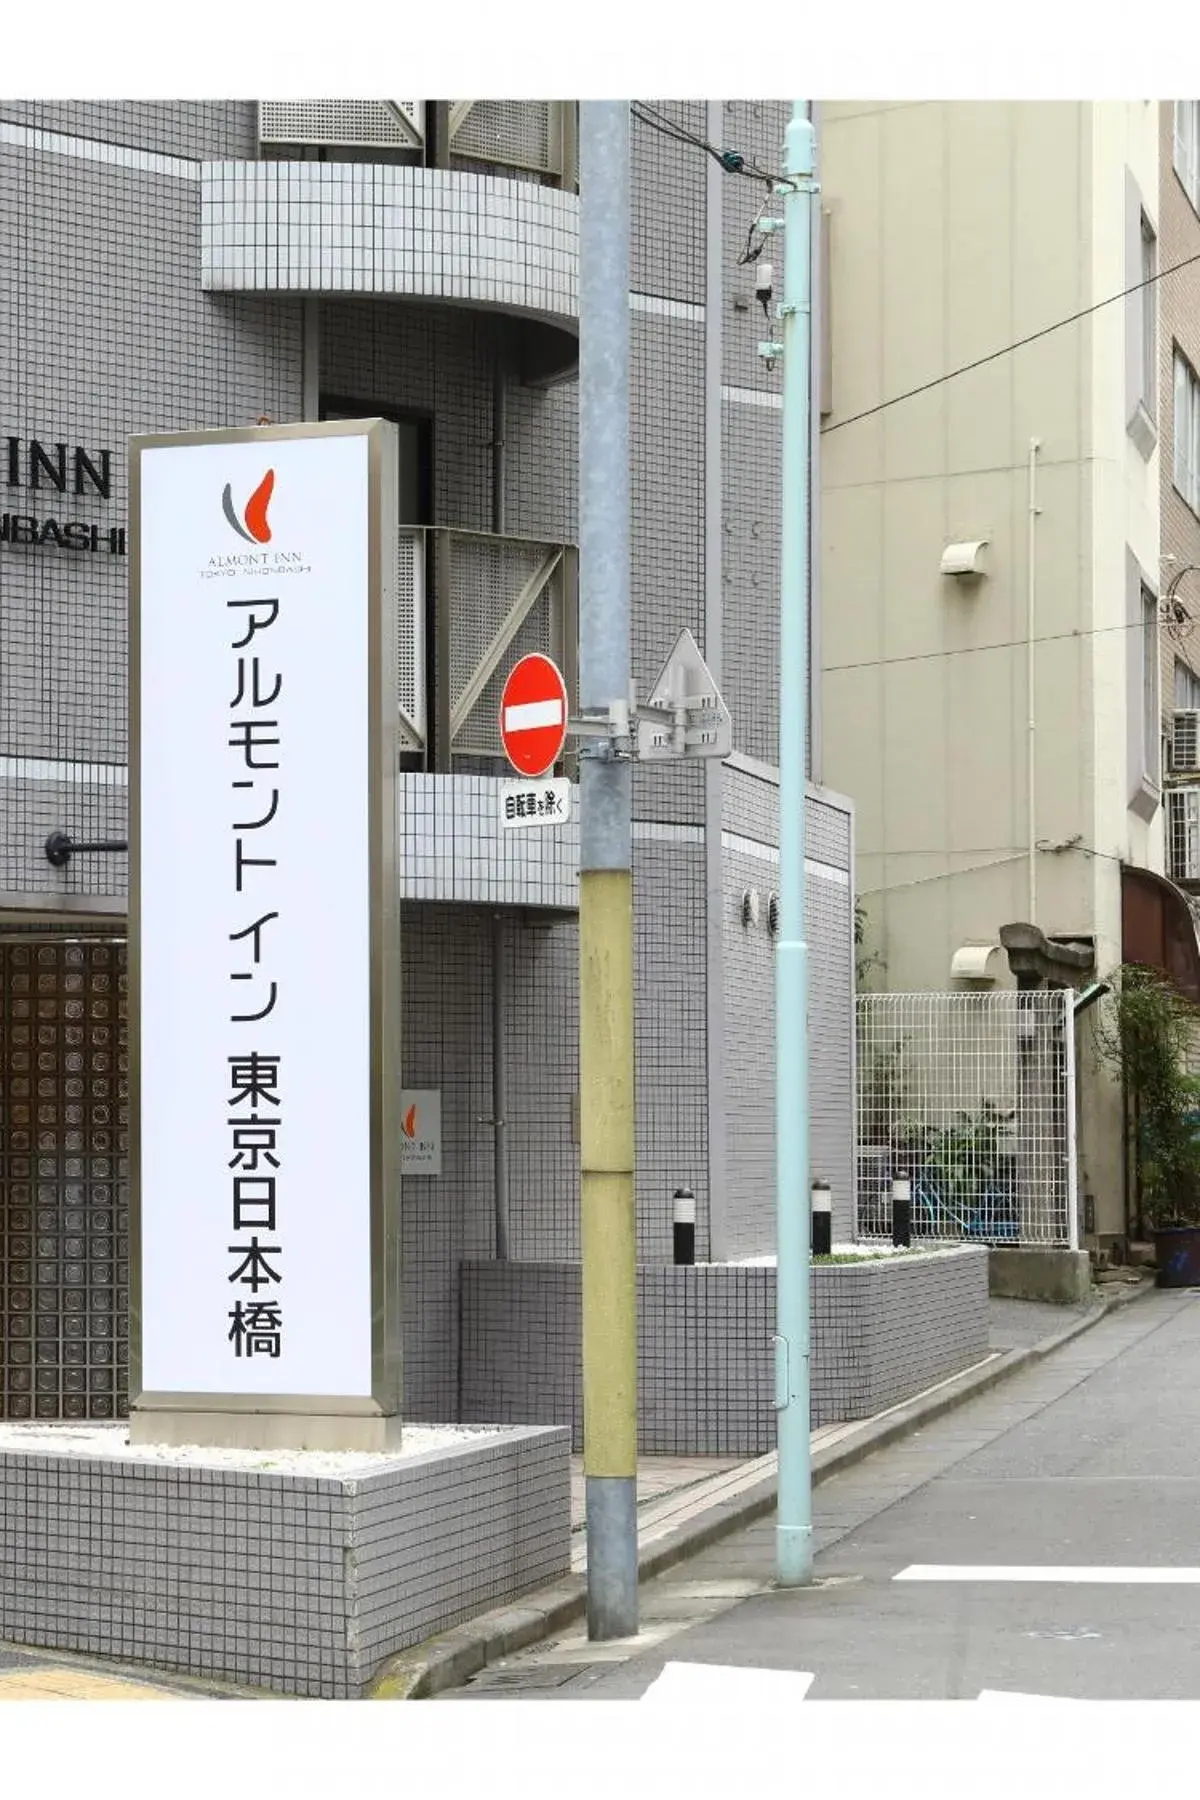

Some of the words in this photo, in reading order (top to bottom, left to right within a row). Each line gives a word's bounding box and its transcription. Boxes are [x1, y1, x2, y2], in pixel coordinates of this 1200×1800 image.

[6, 436, 115, 500] INN
[208, 553, 269, 568] ALMONT
[274, 552, 303, 564] INN
[227, 598, 282, 892] アルモント
[505, 790, 563, 820] 自転車を除く
[228, 911, 280, 1022] イン
[227, 1051, 283, 1358] 東京日本橋
